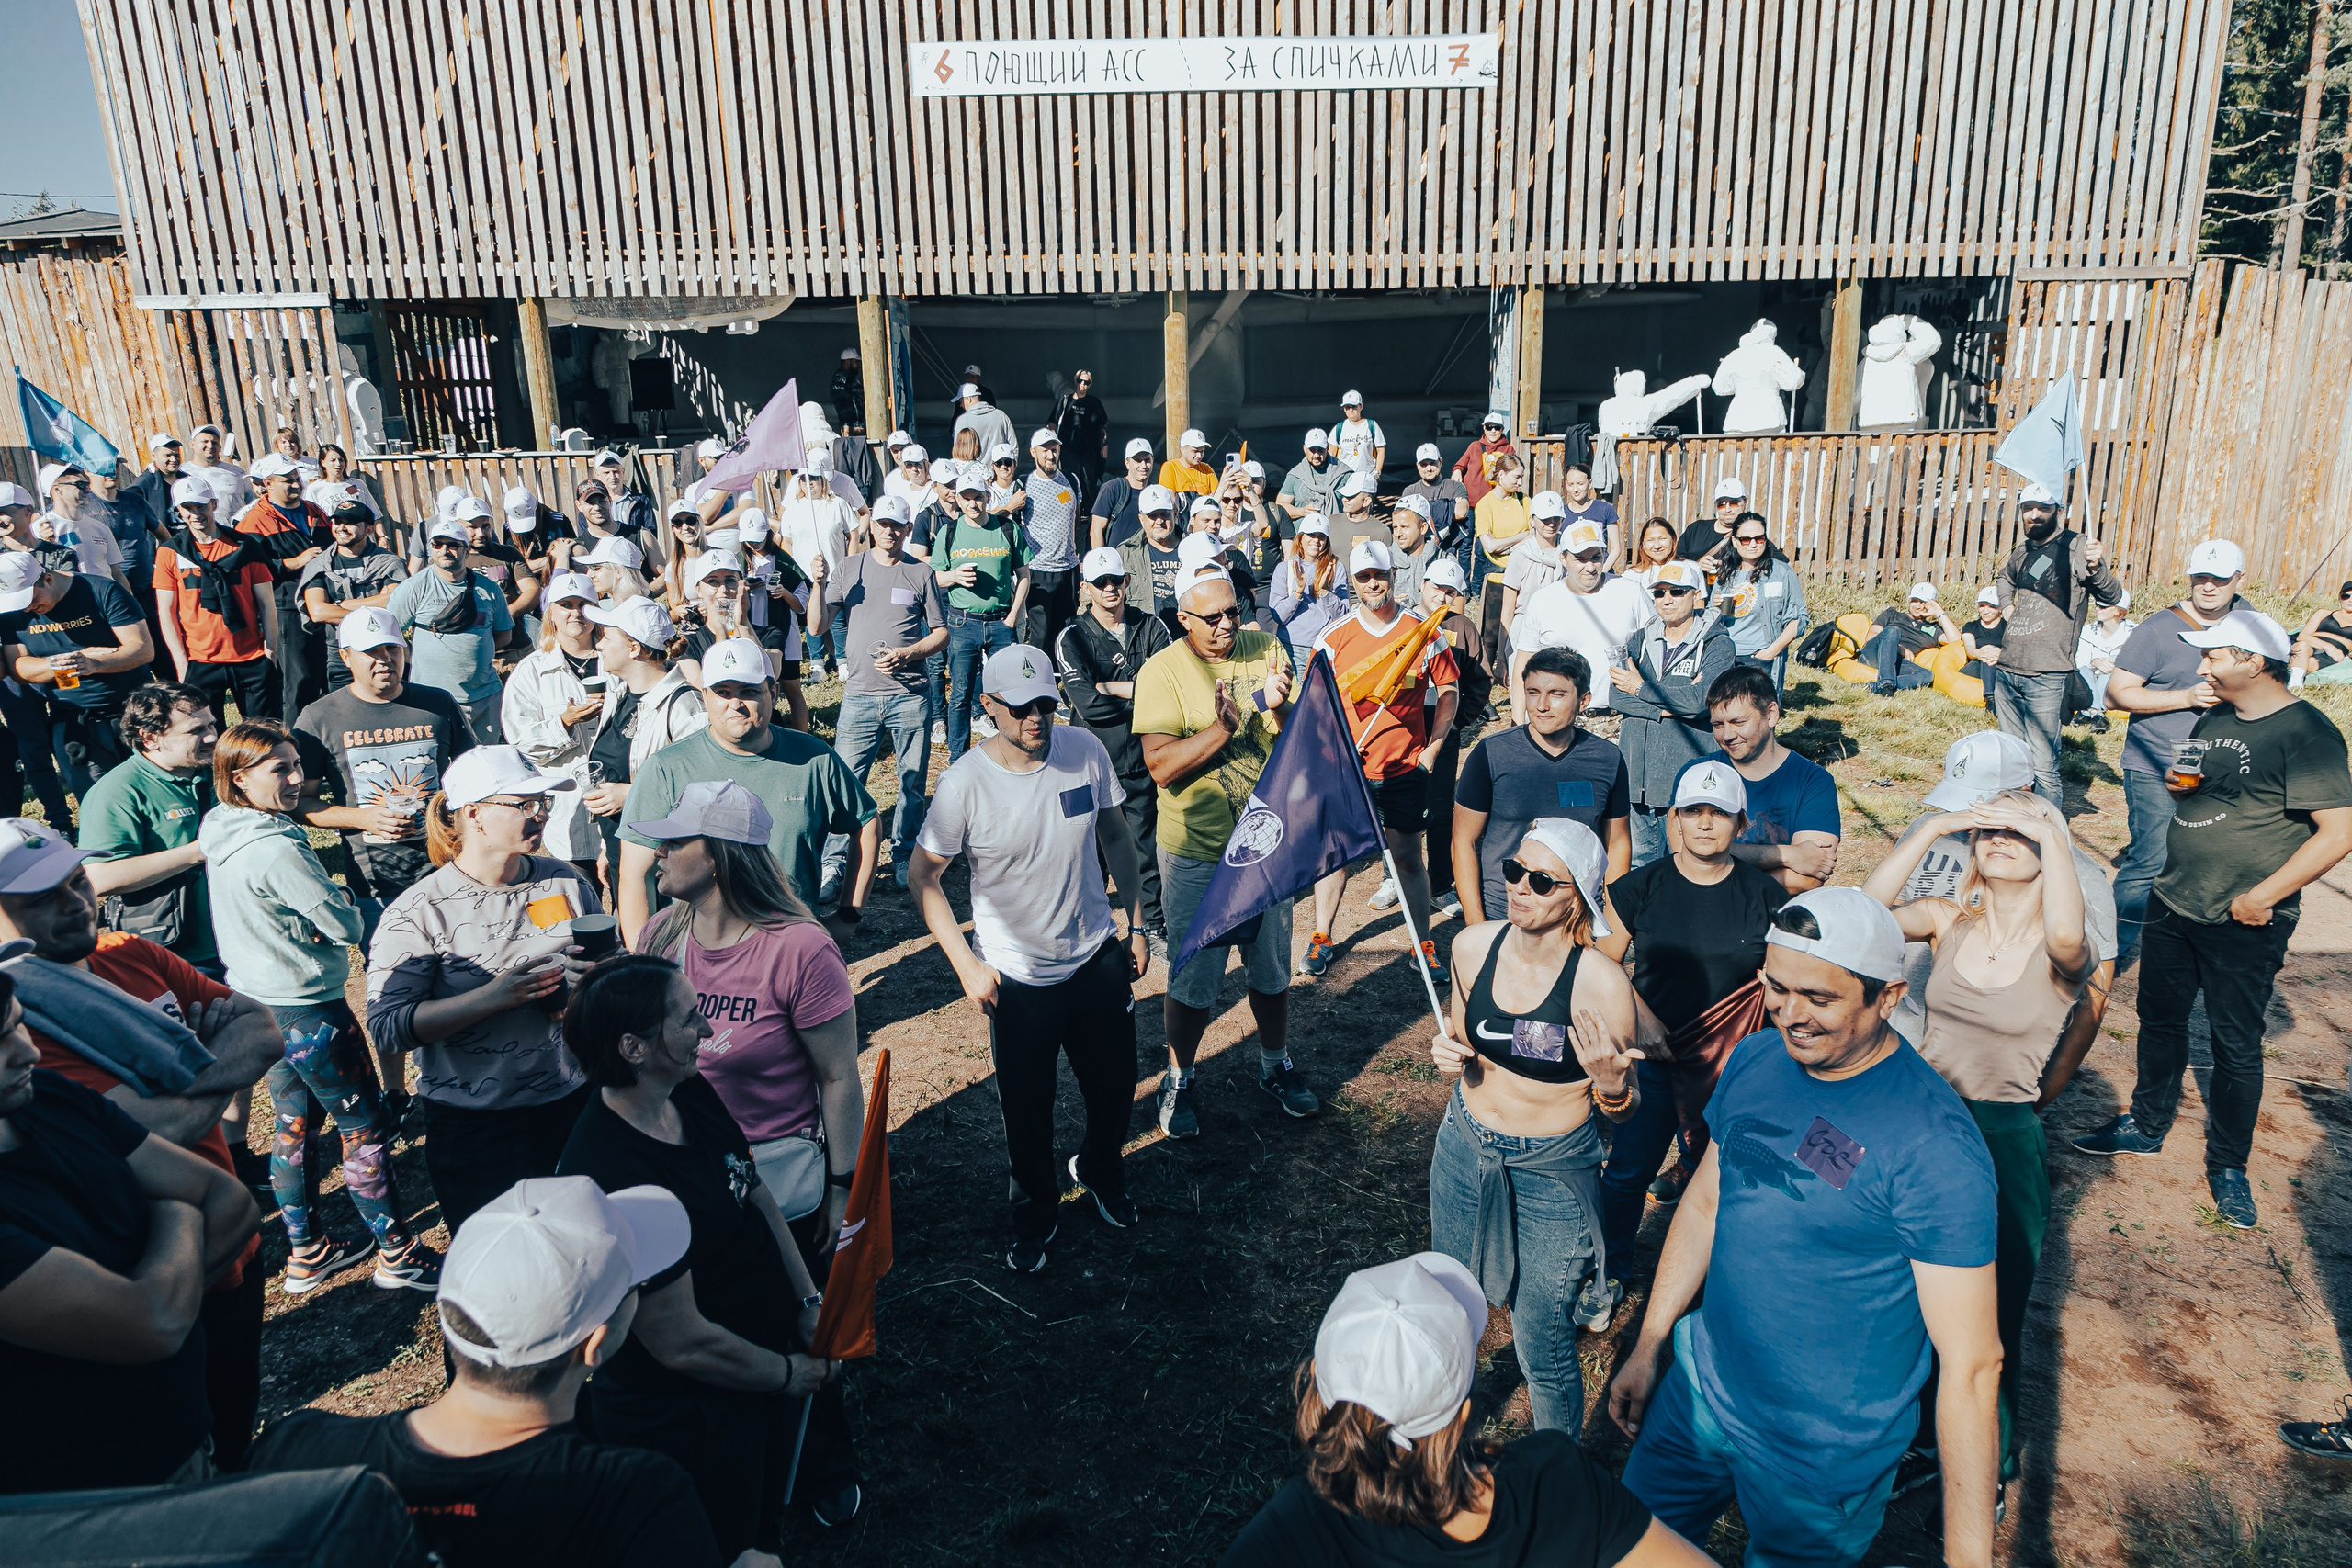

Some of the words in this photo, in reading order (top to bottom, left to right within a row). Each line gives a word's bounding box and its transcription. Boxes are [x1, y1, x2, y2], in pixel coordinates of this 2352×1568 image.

[933, 48, 955, 85] 6
[965, 44, 1087, 87] ПОЮЩИЙ
[1101, 48, 1147, 83] АСС
[1224, 46, 1258, 81] ЗА
[1272, 42, 1438, 80] СПИЧКАМИ
[1447, 43, 1470, 76] 7
[28, 624, 47, 635] NO
[46, 615, 93, 633] WORRIES
[343, 724, 435, 749] CELEBRATE
[2204, 738, 2251, 775] UTHENTIC
[2214, 812, 2227, 821] CO
[696, 993, 758, 1022] OOPER
